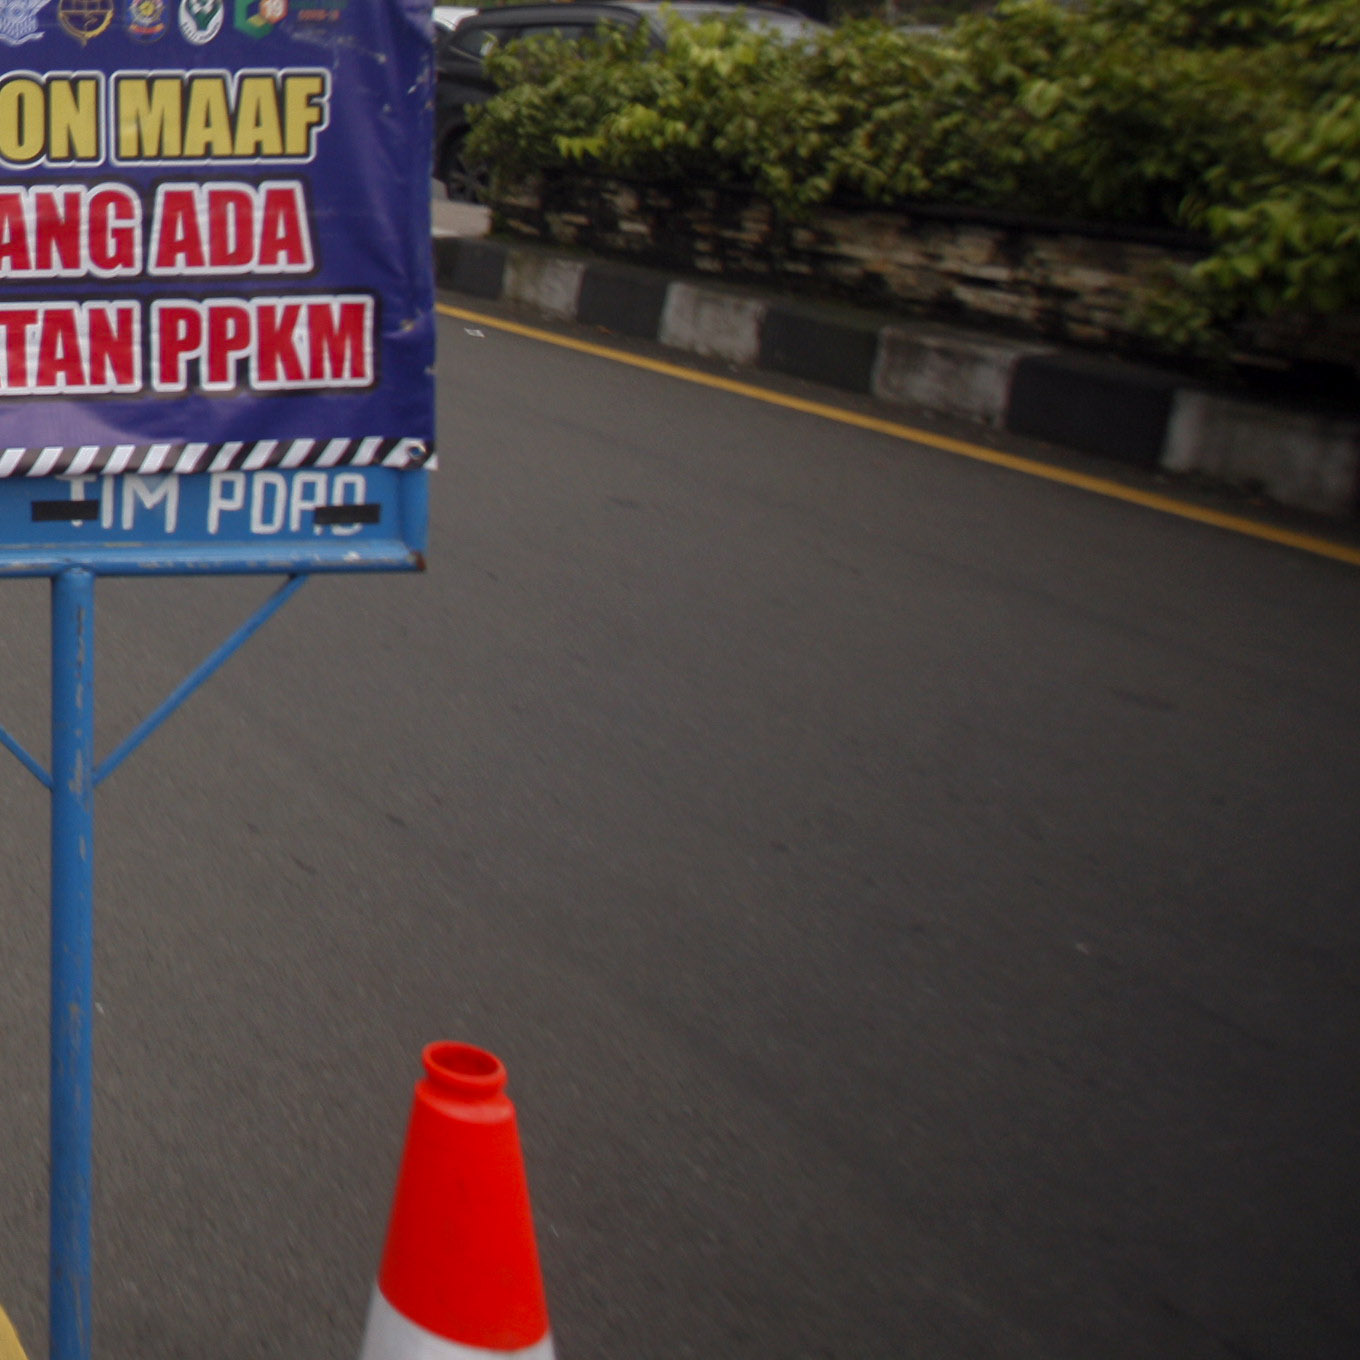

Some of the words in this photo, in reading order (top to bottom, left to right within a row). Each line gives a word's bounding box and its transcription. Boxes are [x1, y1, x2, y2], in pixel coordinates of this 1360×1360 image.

[113, 71, 326, 162] MAAF
[150, 183, 311, 273] ADA
[152, 297, 372, 390] PPKM
